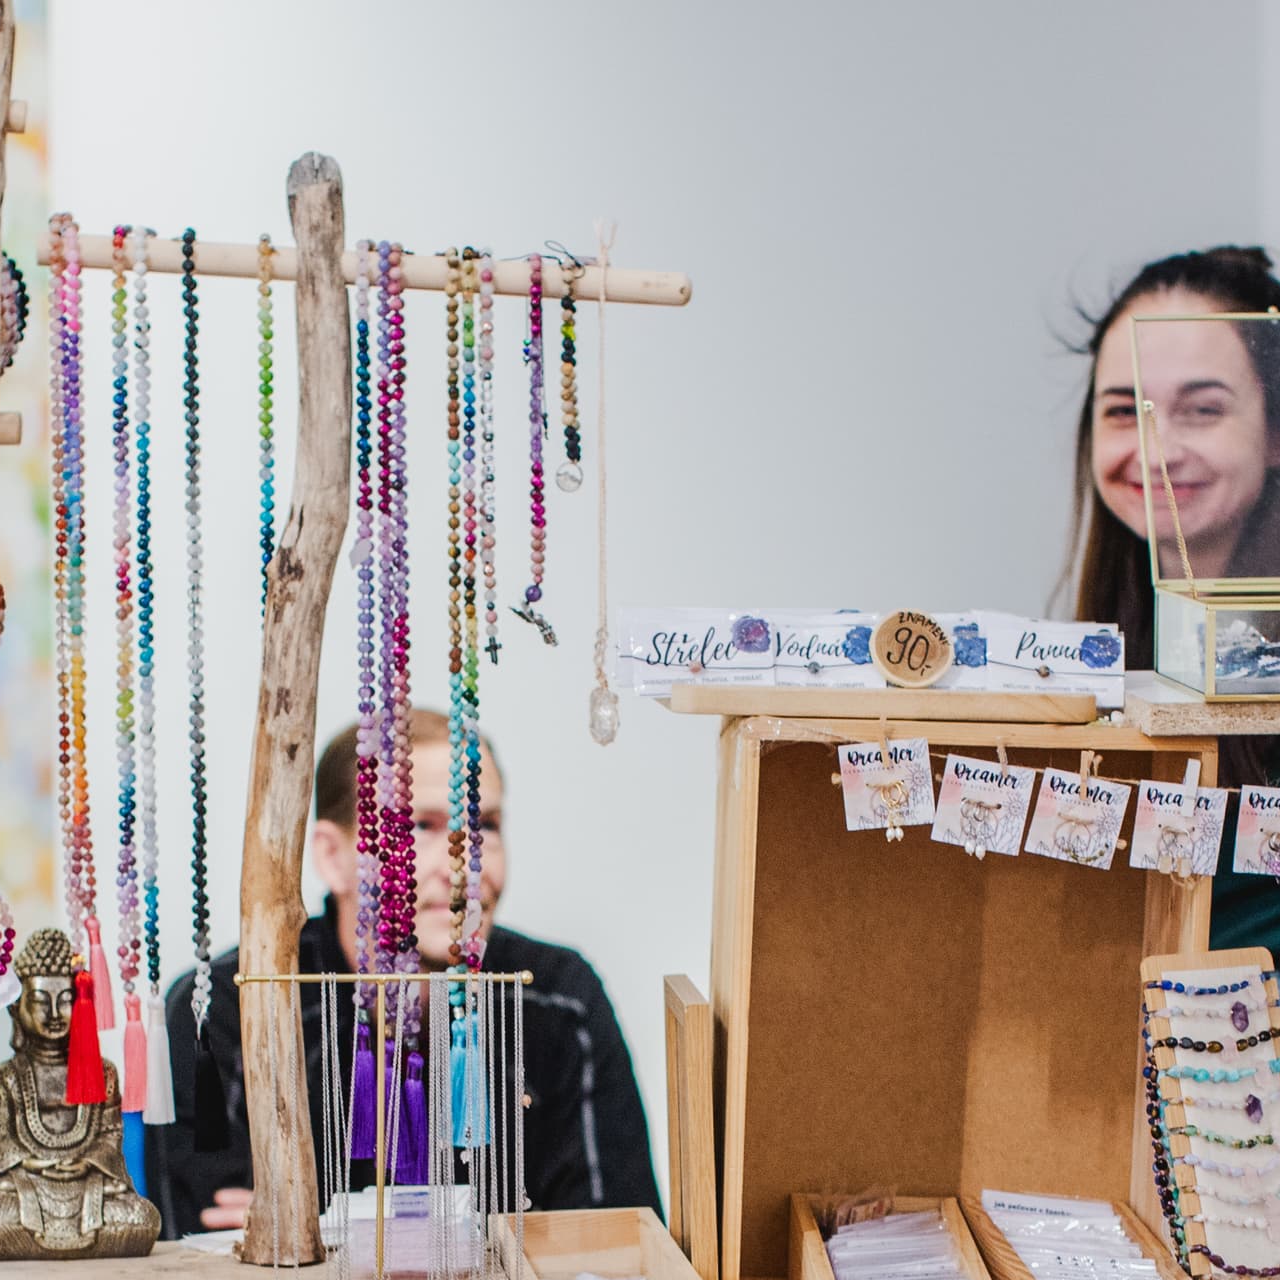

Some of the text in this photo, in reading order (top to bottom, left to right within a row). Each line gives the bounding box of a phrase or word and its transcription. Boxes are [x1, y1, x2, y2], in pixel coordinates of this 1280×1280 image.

[1015, 631, 1083, 660] Panna
[954, 761, 1020, 790] Dreamer
[1147, 787, 1212, 811] Dreaer
